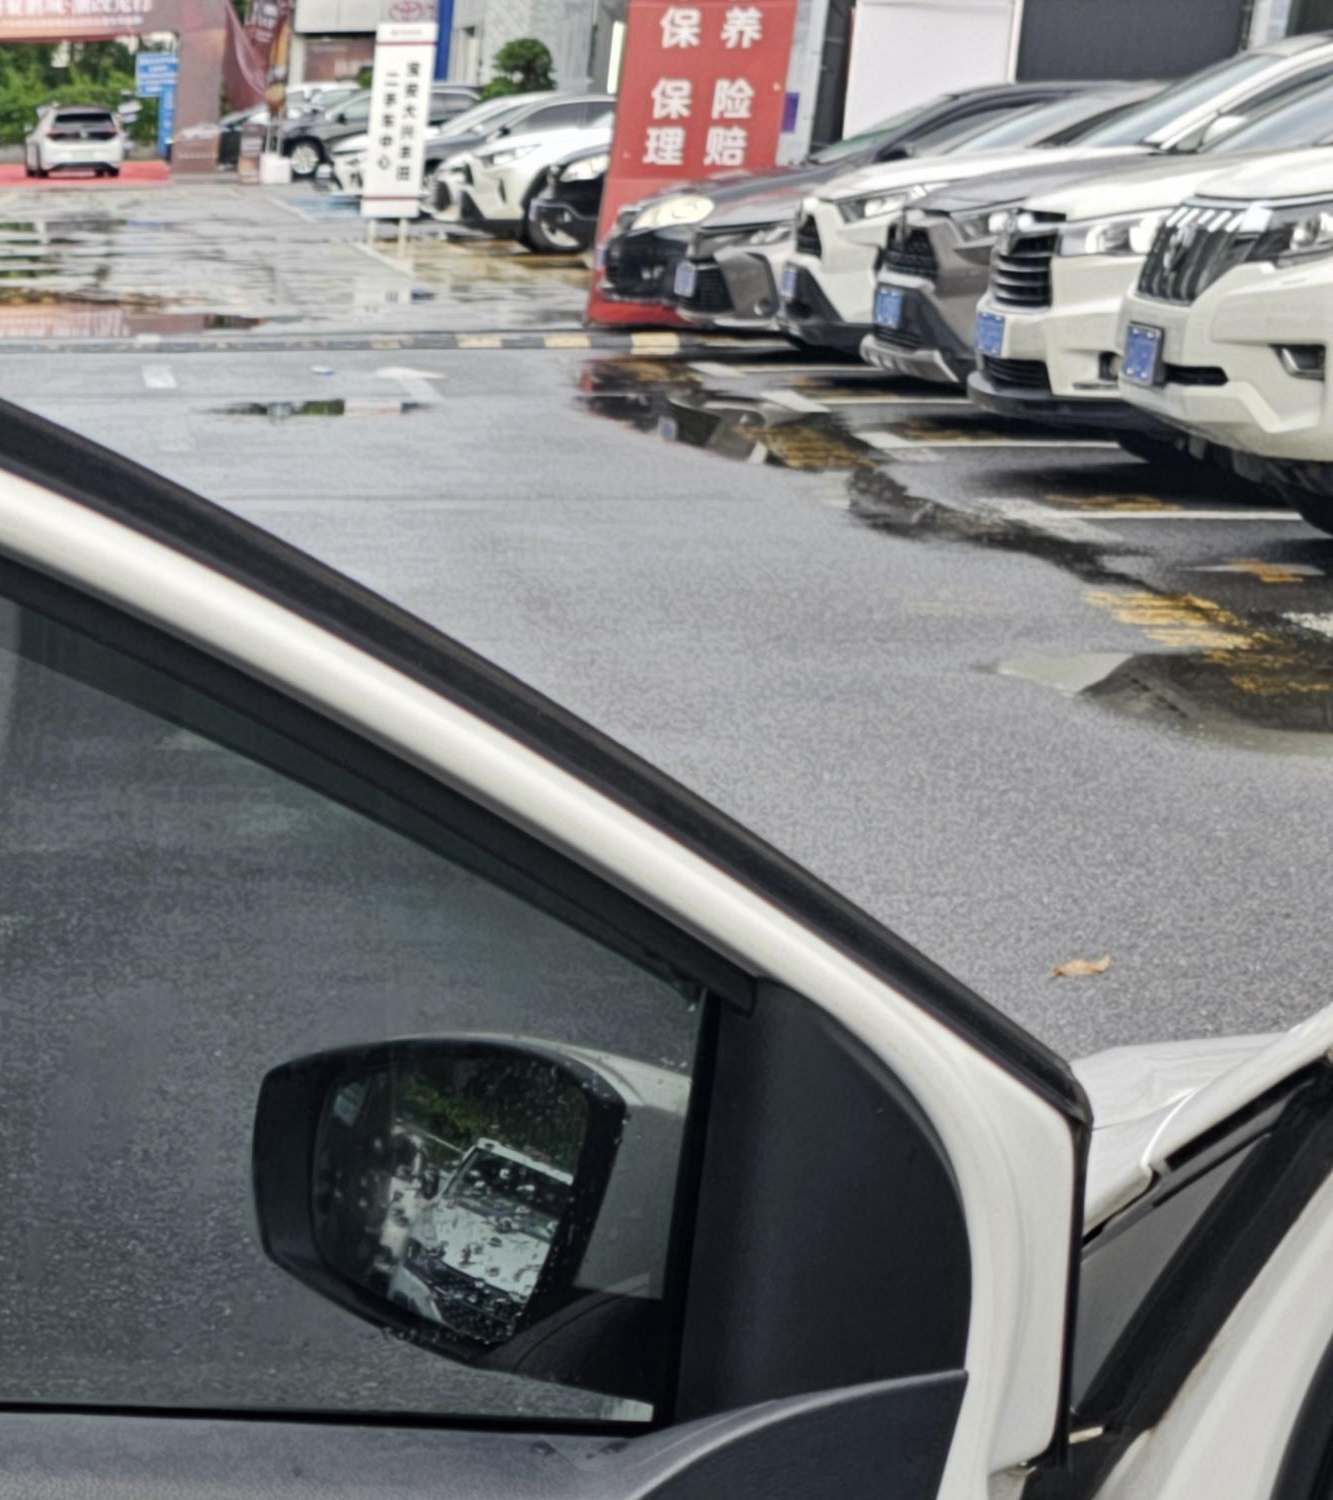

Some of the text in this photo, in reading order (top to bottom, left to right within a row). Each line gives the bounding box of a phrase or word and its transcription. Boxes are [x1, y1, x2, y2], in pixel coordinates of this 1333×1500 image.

[659, 6, 763, 49] 保养
[650, 77, 756, 120] 保险
[377, 71, 400, 171] 二手车中心
[642, 126, 748, 166] 理赔
